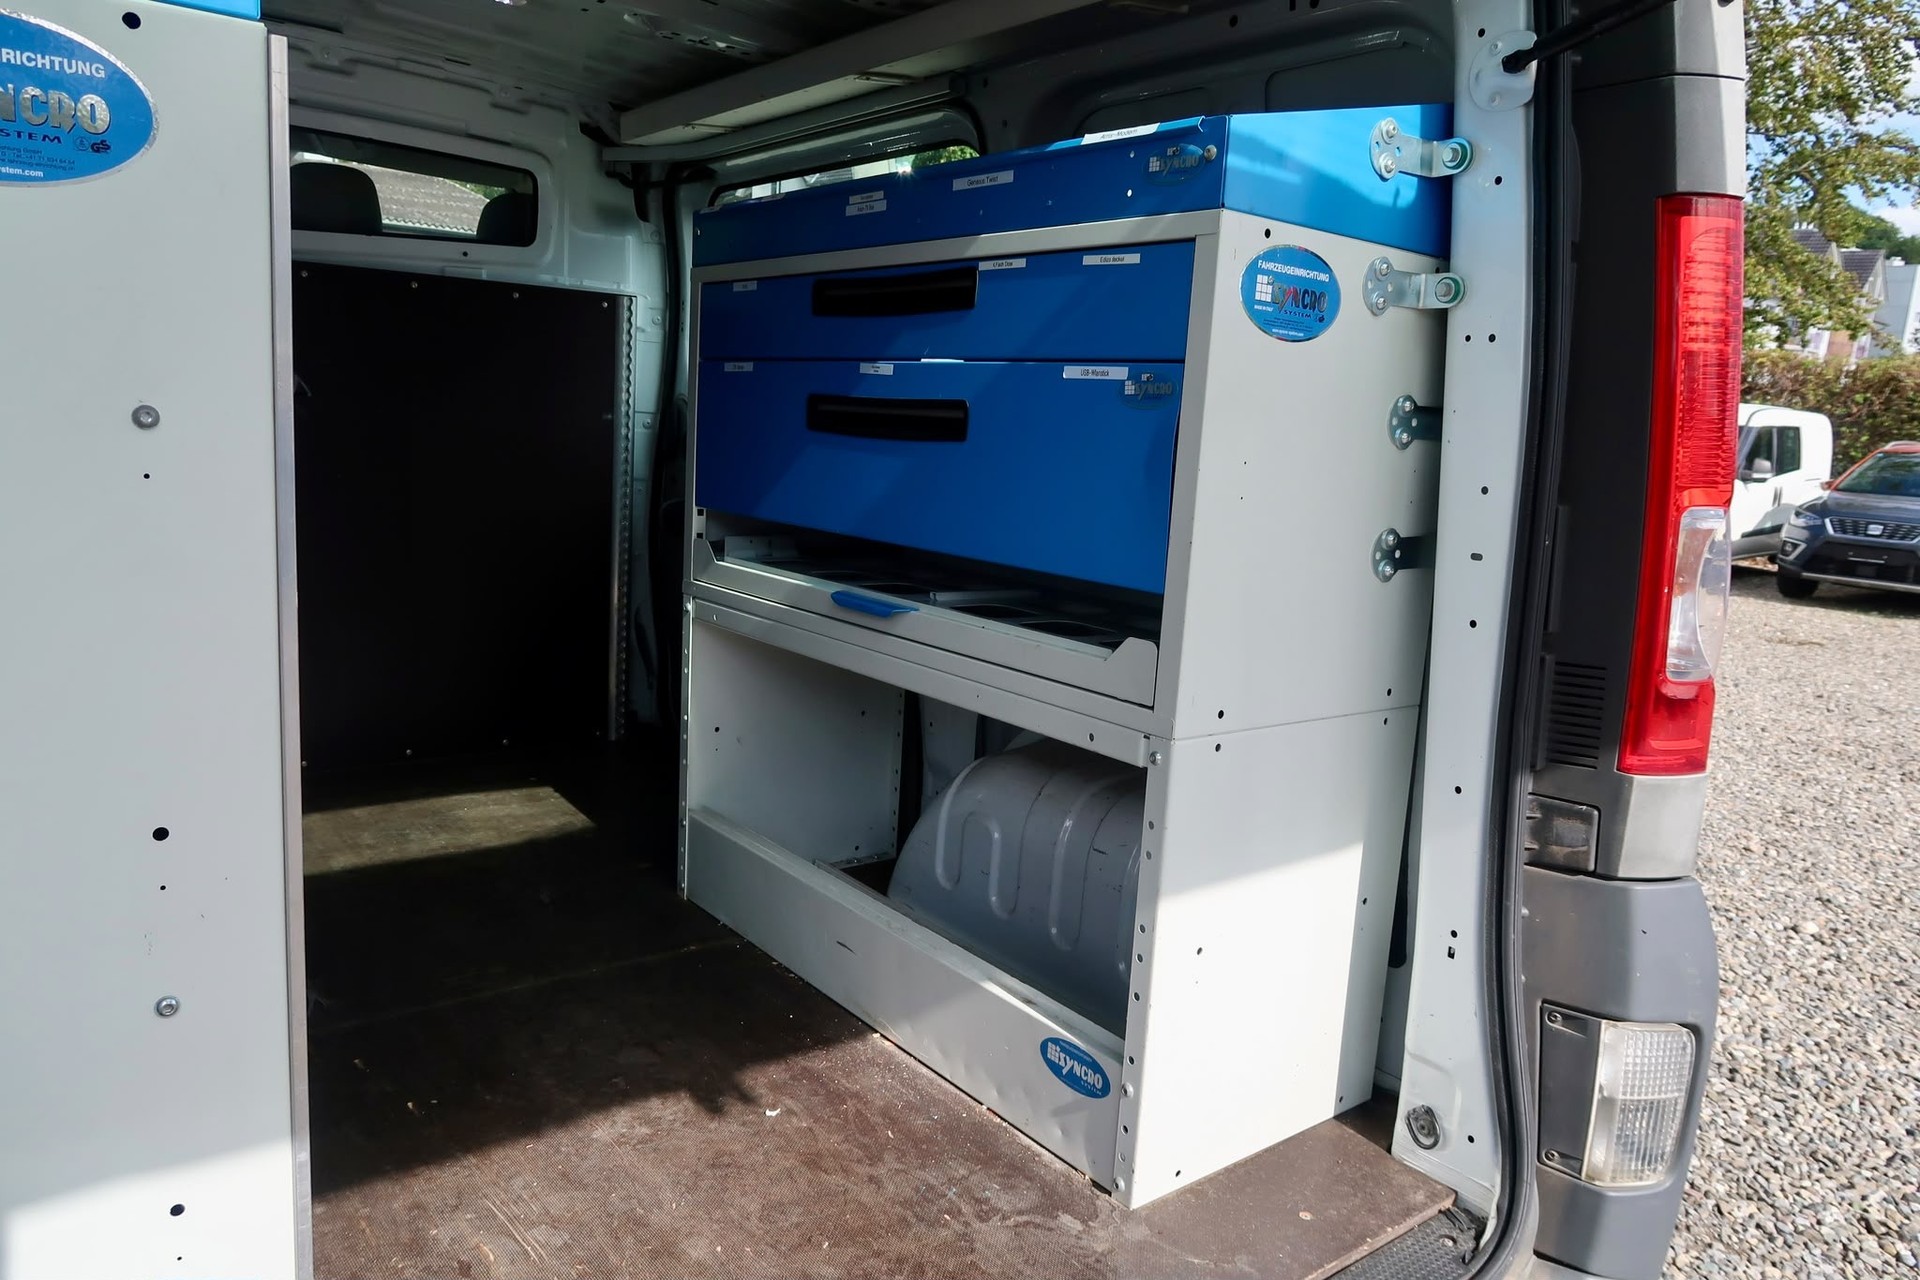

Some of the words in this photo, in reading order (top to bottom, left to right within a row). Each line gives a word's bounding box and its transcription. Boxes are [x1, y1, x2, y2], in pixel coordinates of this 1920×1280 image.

[1, 48, 106, 78] RICHTUNG
[1257, 259, 1330, 282] FAHRZEUGEINRICHTUNG
[1271, 282, 1327, 314] SYNCRO
[1283, 310, 1312, 319] SYSTEM
[1059, 1051, 1103, 1090] SYNCRO
